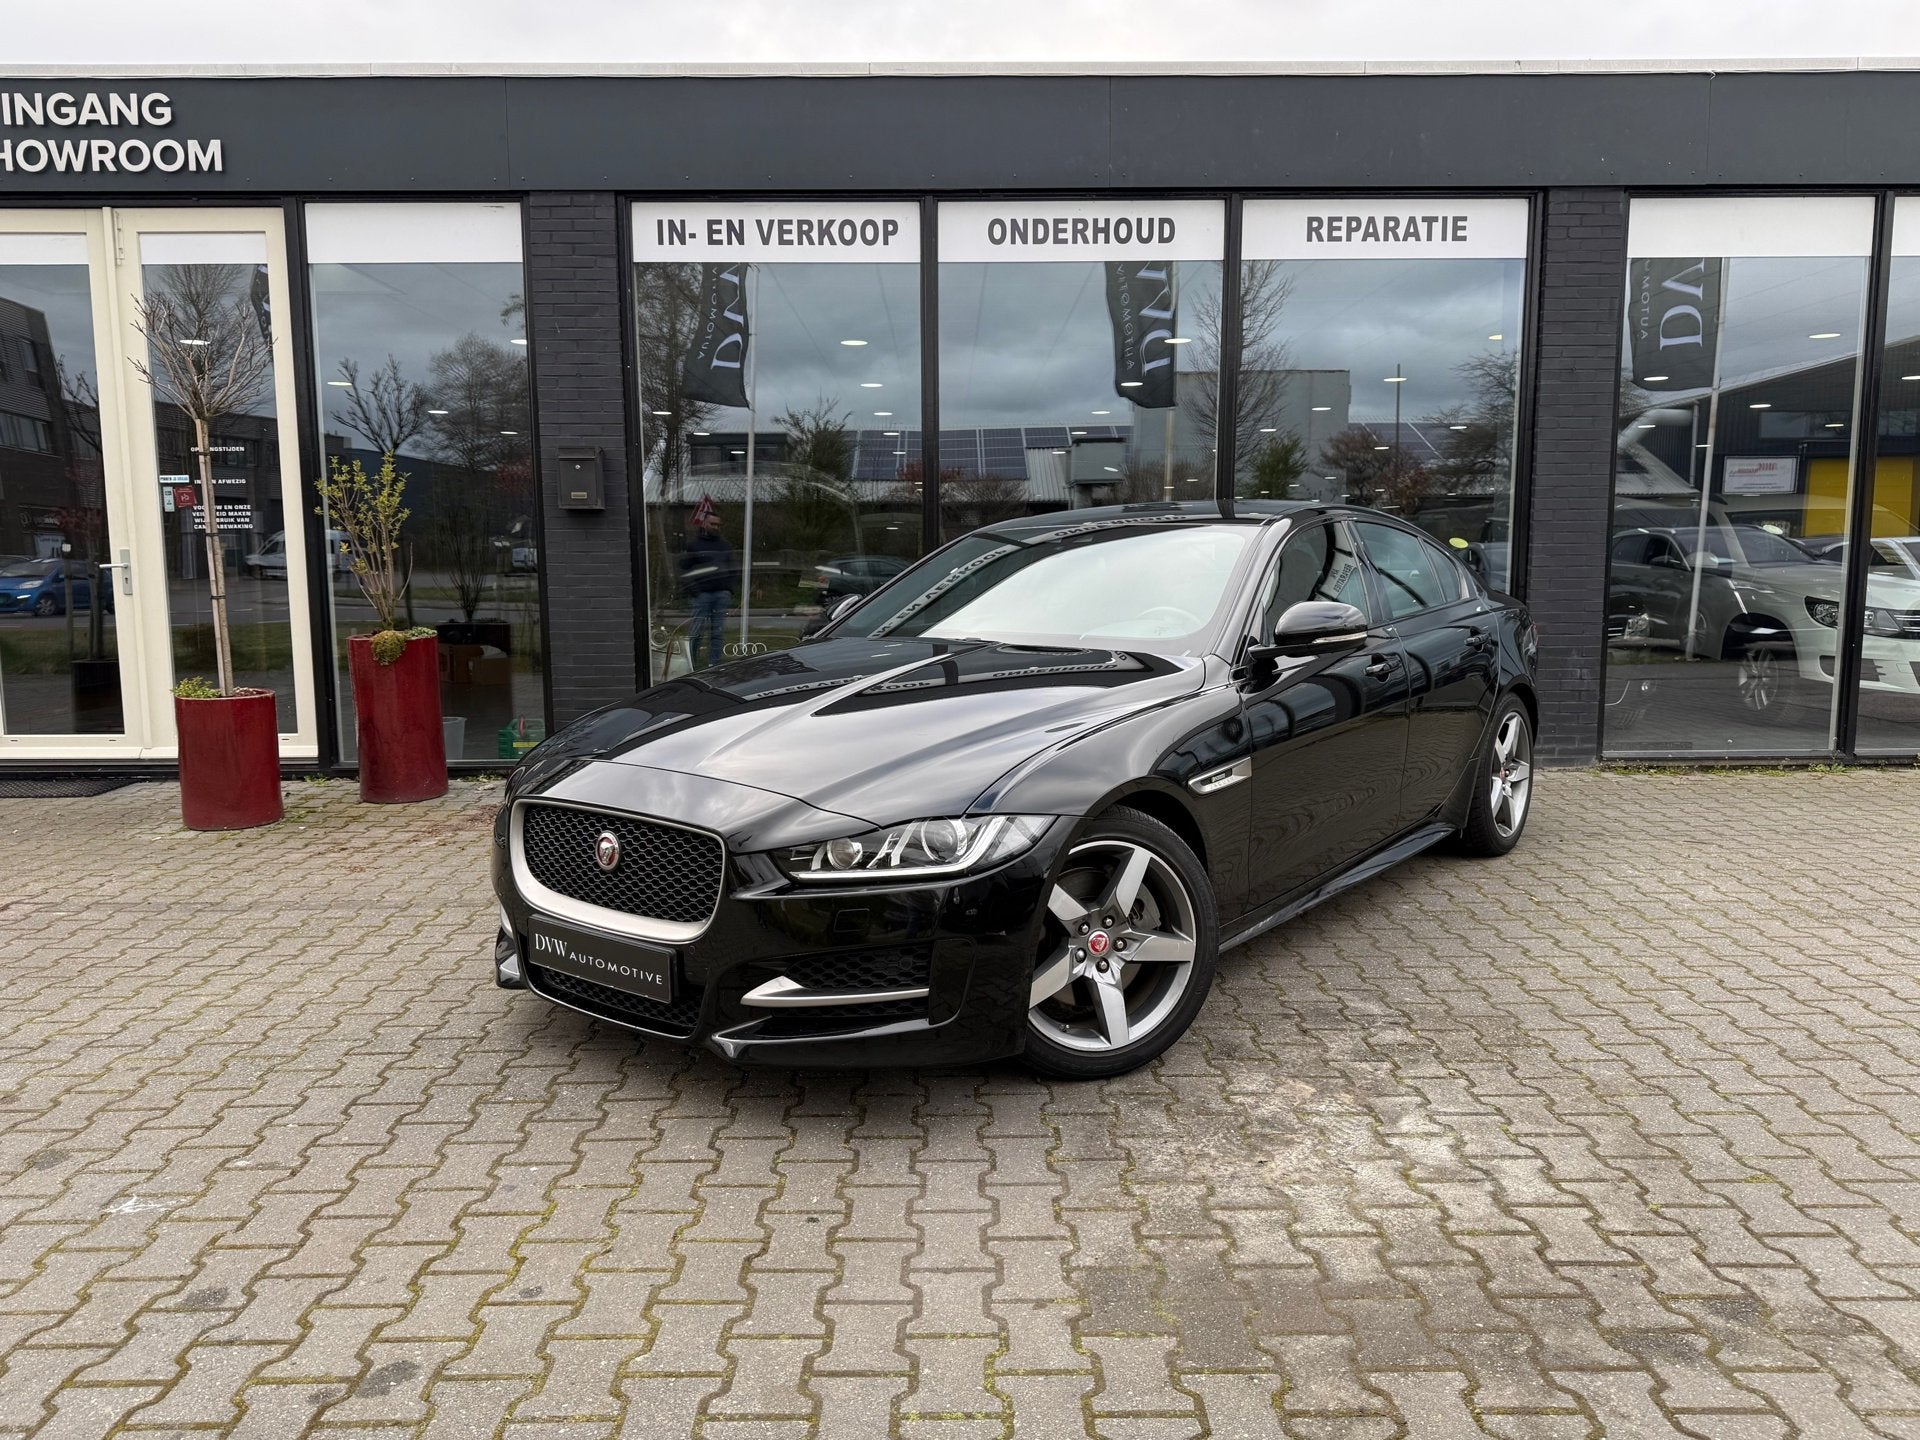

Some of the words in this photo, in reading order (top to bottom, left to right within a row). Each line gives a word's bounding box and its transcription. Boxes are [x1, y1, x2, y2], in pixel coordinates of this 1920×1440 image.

[657, 219, 697, 245] IN-
[706, 219, 745, 245] EN
[755, 219, 899, 246] VERKOOP
[987, 217, 1176, 245] ONDERHOUD
[1306, 216, 1468, 242] REPARATIE
[535, 933, 568, 957] DVW
[569, 951, 663, 985] AUTOMOTIVE
